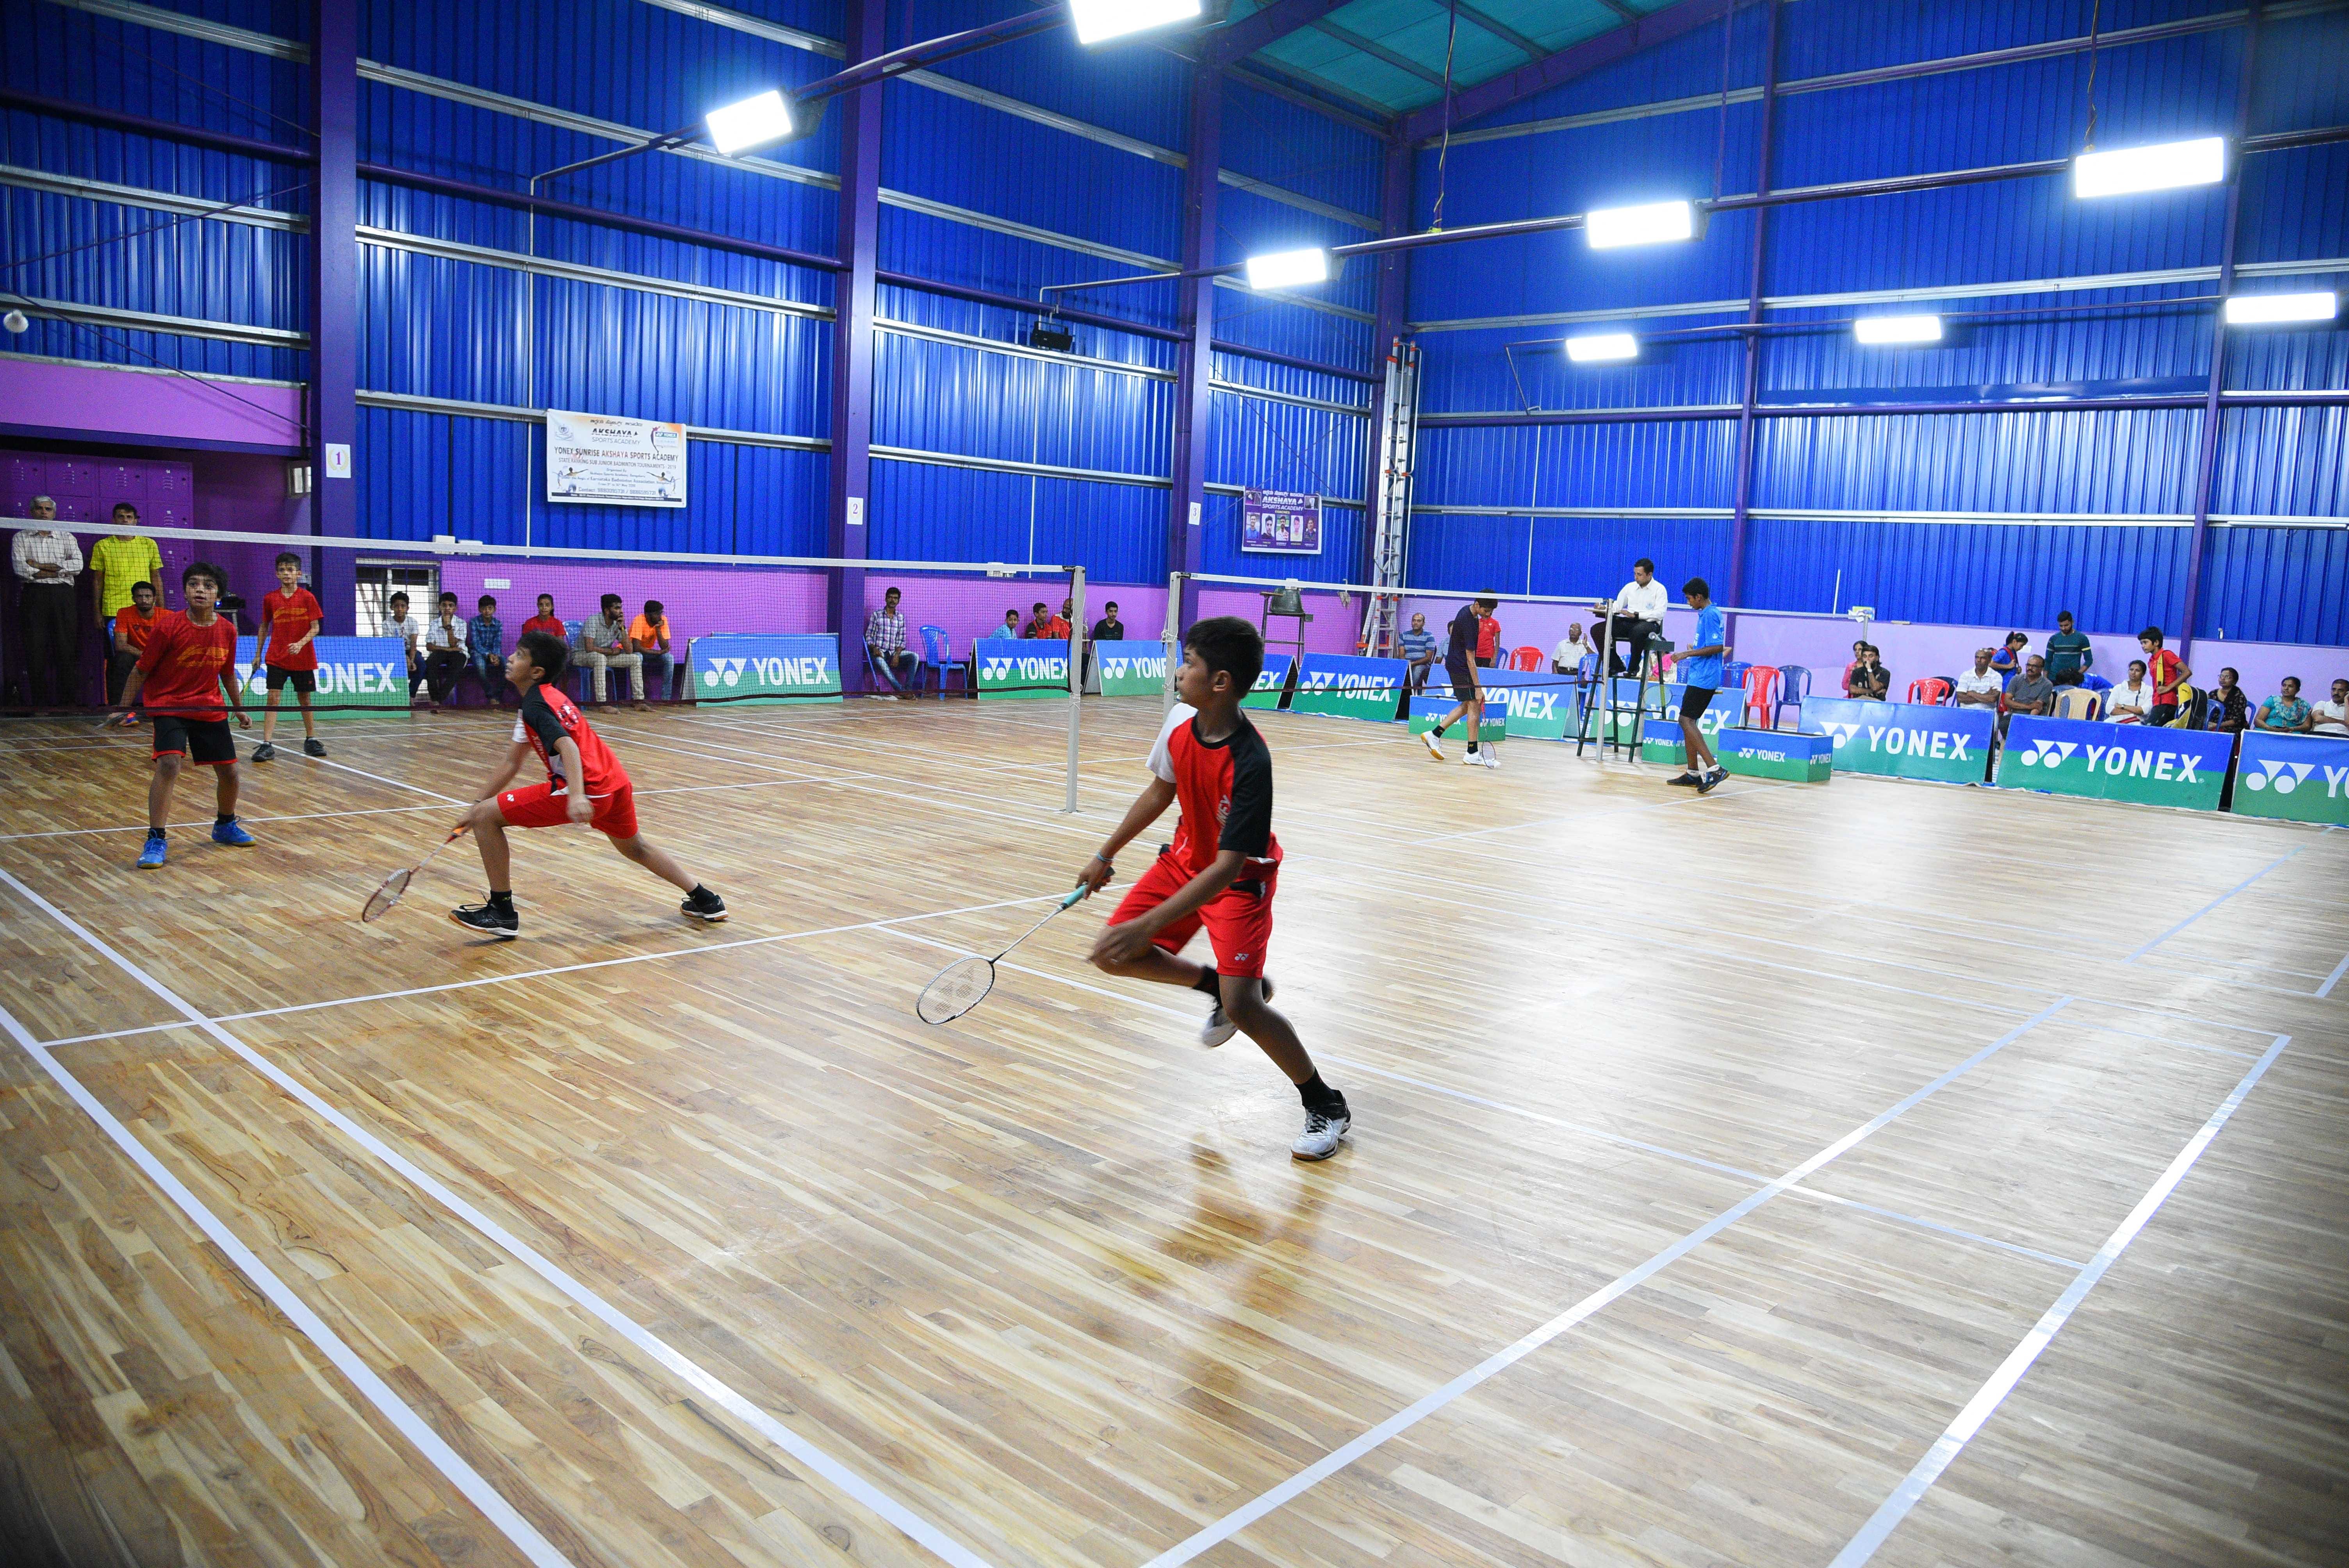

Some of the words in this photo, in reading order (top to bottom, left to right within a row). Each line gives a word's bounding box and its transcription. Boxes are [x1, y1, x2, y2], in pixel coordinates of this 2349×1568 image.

[335, 452, 342, 465] 1
[554, 447, 574, 455] YONEX
[576, 448, 600, 457] SUNRISE
[602, 450, 628, 458] AKSHAYA
[630, 452, 651, 460] SPORTS
[652, 453, 679, 461] ACADEMY
[1262, 496, 1297, 505] AKSHAYA
[853, 504, 858, 515] 2
[1193, 507, 1197, 517] 3
[752, 657, 831, 686] YONEX
[1016, 657, 1068, 680] YONEX
[314, 663, 396, 694] ONEX
[1337, 673, 1395, 702] YONEX
[1490, 718, 1505, 727] YONEX
[1655, 738, 1673, 747] YONEX
[1868, 725, 1971, 761] YONEX
[1756, 749, 1786, 763] YONEX
[1818, 753, 1831, 764] YONEX
[2086, 744, 2202, 784] YONEX
